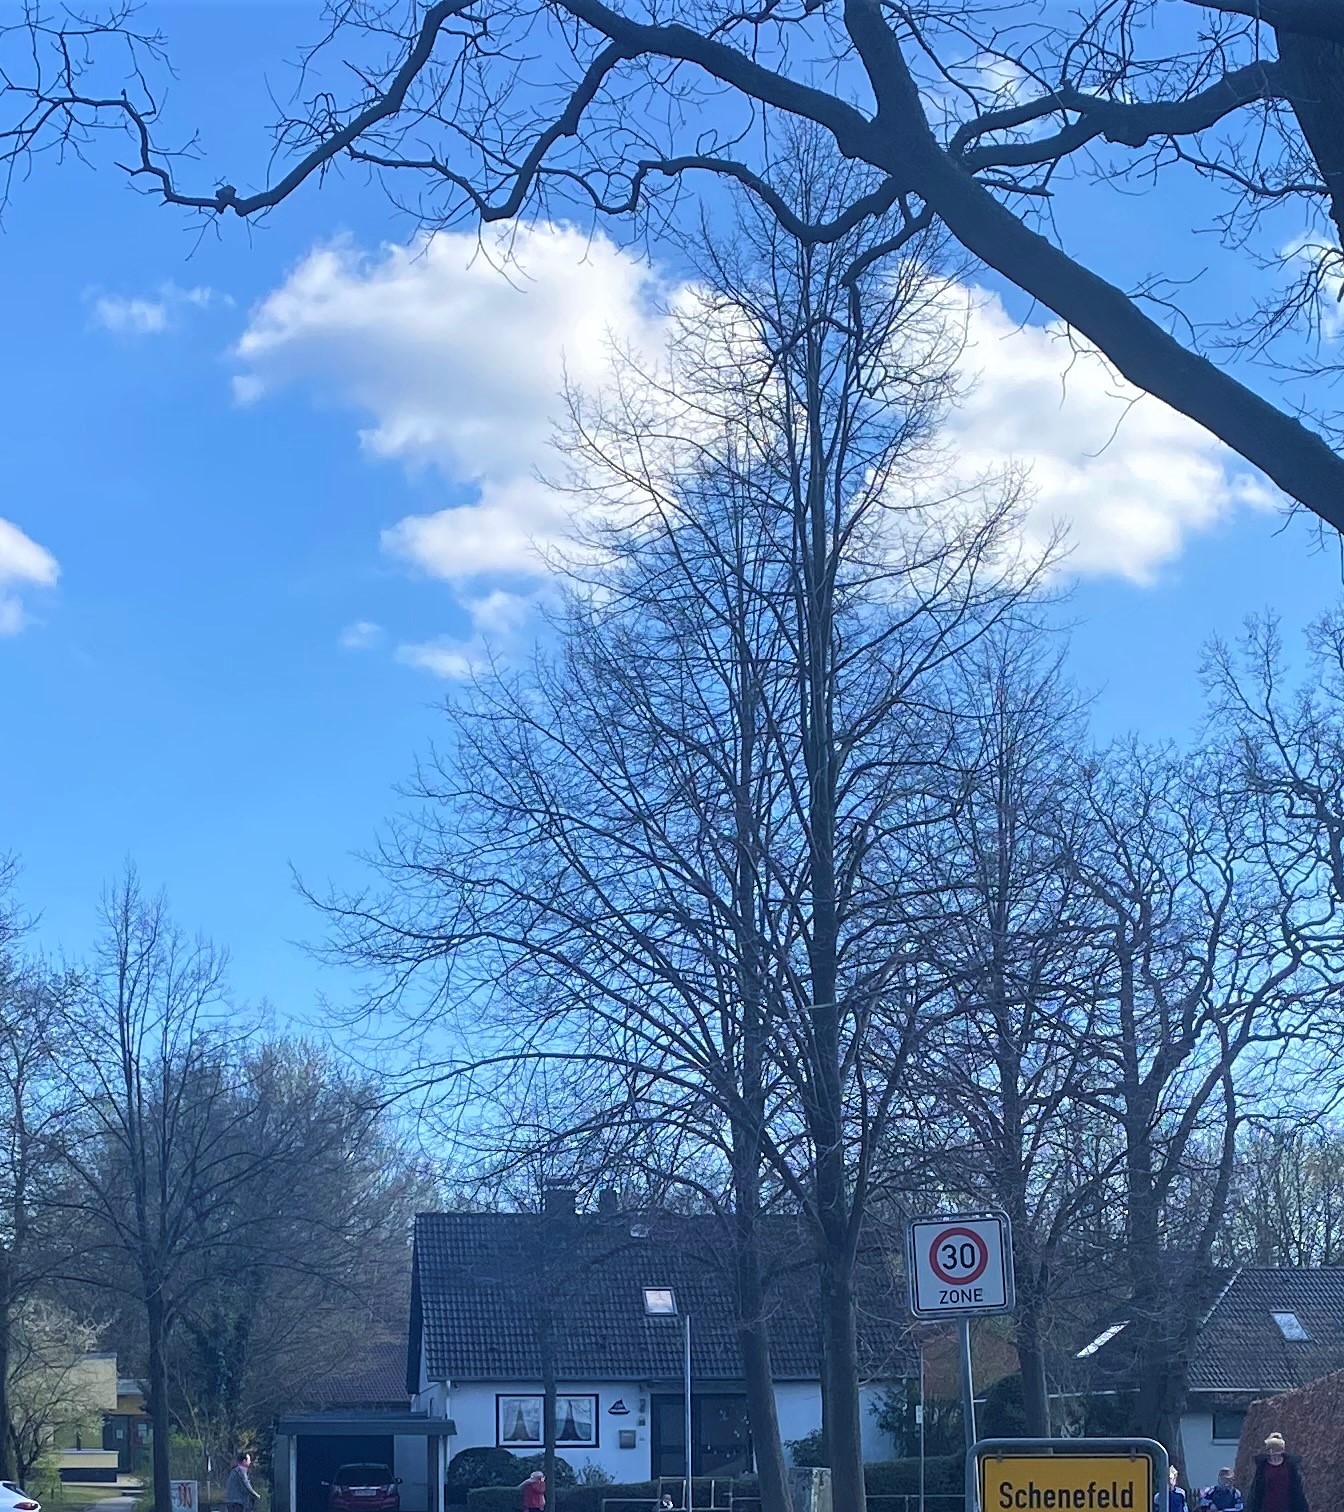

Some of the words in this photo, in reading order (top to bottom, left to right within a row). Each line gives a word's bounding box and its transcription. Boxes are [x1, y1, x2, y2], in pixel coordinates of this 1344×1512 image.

[940, 1242, 976, 1270] 30
[939, 1288, 984, 1304] ZONE
[999, 1481, 1134, 1509] Schenefeld
